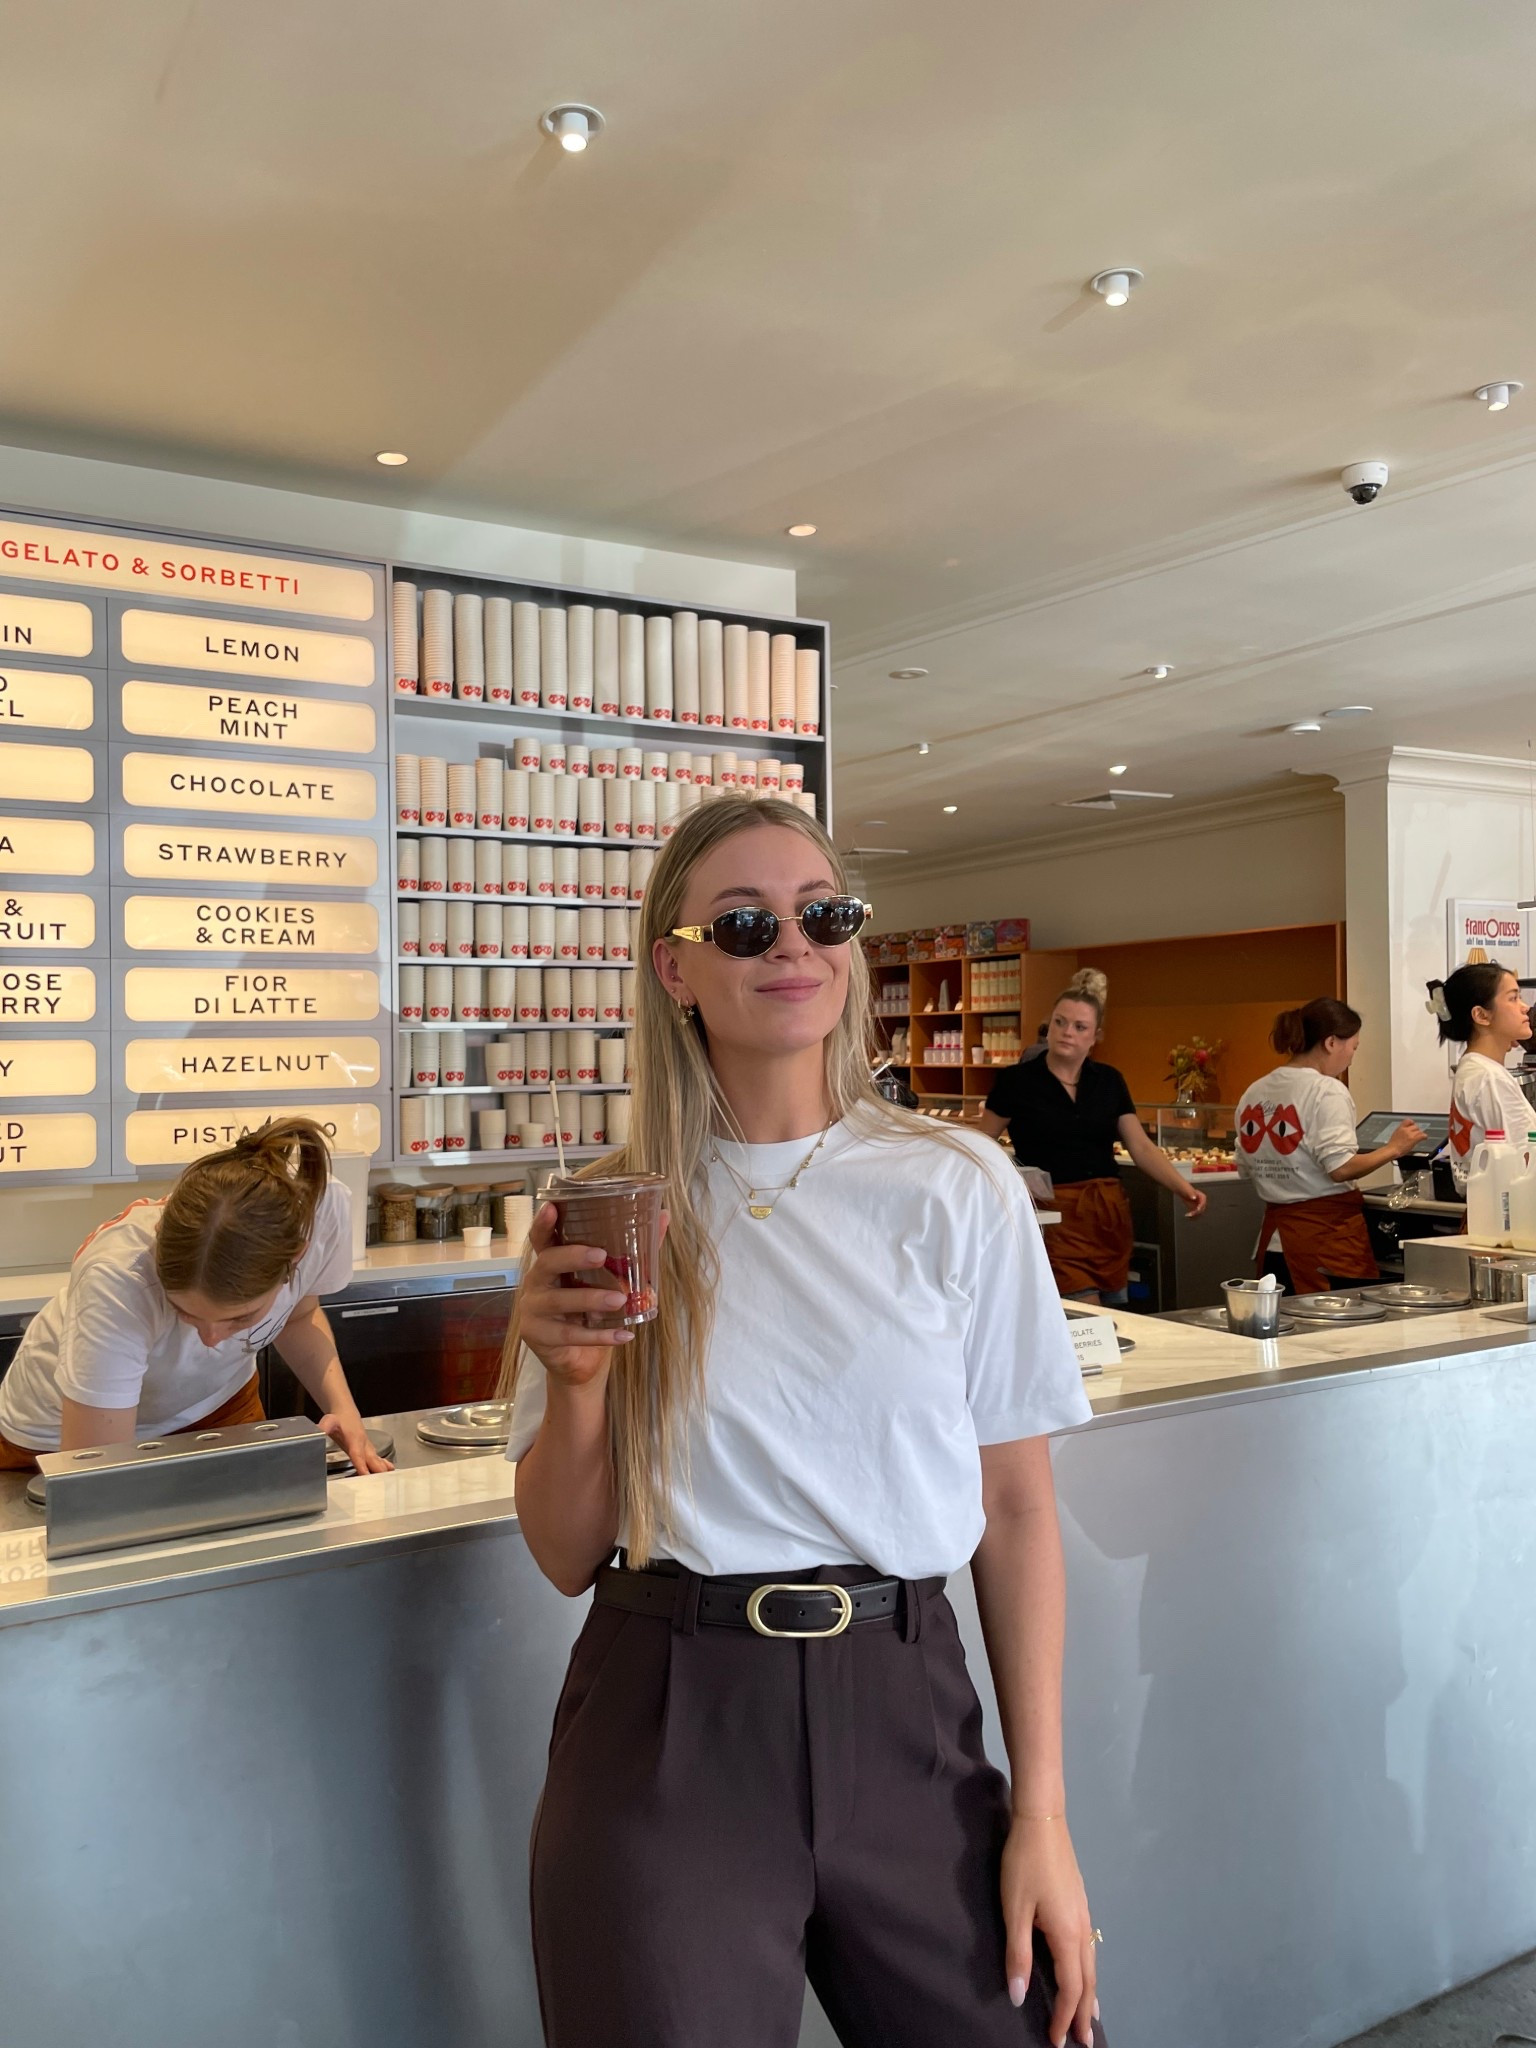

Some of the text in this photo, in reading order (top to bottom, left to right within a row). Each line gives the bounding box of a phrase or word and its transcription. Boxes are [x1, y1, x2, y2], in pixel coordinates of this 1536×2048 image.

[1, 540, 299, 595] GELATO & SORBETTI
[205, 636, 299, 662] LEMON
[209, 695, 298, 719] PEACH
[220, 718, 288, 740] MINT
[170, 774, 334, 801] CHOCOLATE
[158, 843, 347, 868] STRAWBERRY
[4, 898, 23, 917] &
[196, 905, 315, 924] COOKIES
[196, 926, 315, 946] & CREAM
[225, 976, 288, 992] FIOR
[194, 997, 318, 1014] DI LATTE
[182, 1055, 330, 1074] HAZELNUT
[1074, 1339, 1103, 1349] BERRIES
